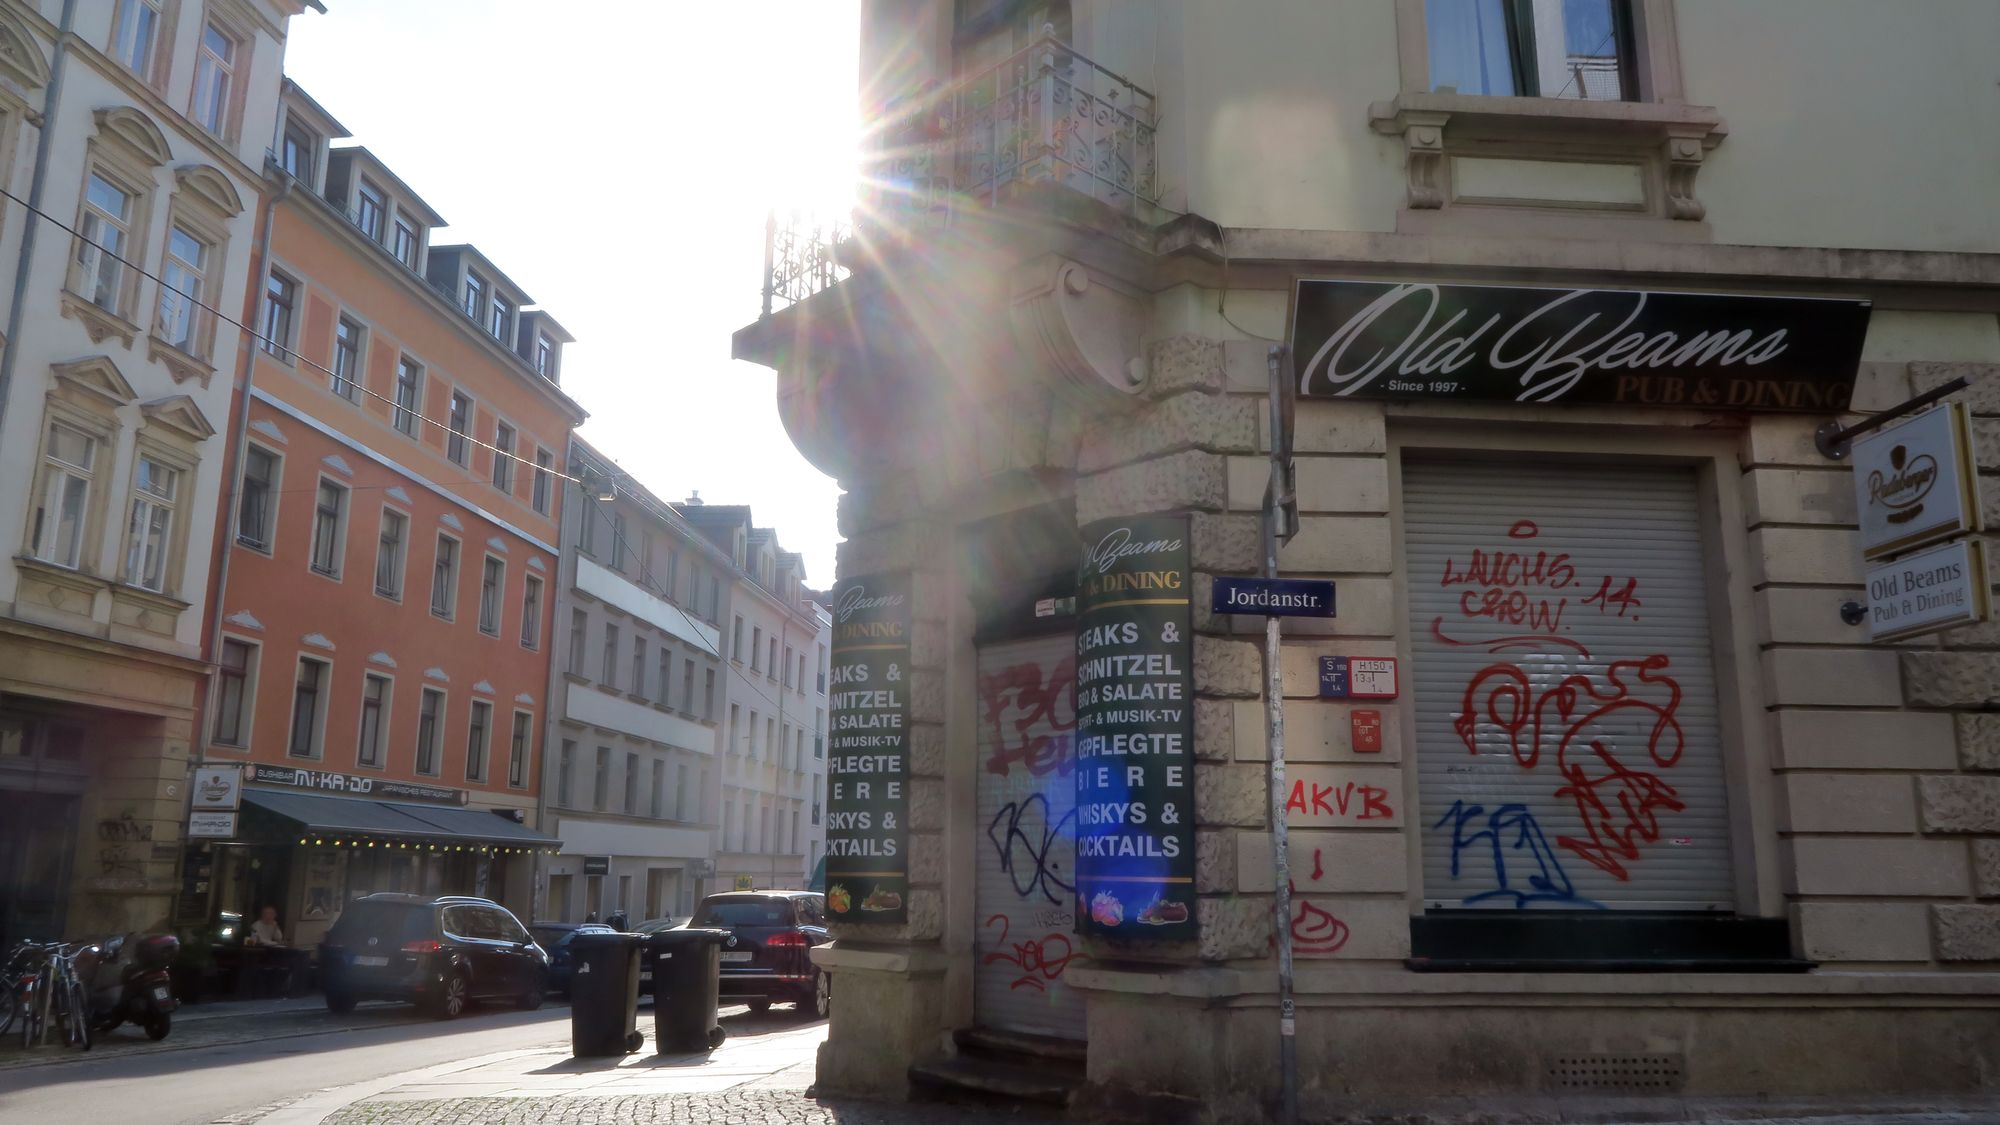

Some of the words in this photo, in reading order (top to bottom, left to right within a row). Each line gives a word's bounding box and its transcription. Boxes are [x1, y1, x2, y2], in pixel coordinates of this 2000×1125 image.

[1301, 282, 1495, 396] Old
[1489, 289, 1788, 402] Beams
[1388, 379, 1424, 392] Since
[1428, 381, 1459, 393] 1997
[1616, 375, 1684, 403] PUB
[1692, 377, 1719, 404] &
[1727, 379, 1850, 409] DINING
[1093, 527, 1183, 573] Beams
[1102, 570, 1181, 591] DINING
[1871, 574, 1898, 601] Old
[1903, 562, 1962, 592] Beams
[836, 585, 904, 623] Beams
[1227, 587, 1322, 608] Jordanstr.
[1873, 603, 1898, 624] Pub
[1902, 599, 1913, 616] &
[1916, 587, 1965, 612] Dining
[1078, 622, 1139, 656] STEAKS
[1161, 621, 1180, 643] &
[886, 663, 902, 681] &
[1078, 654, 1182, 686] SCHNITZEL
[1091, 686, 1099, 704] &
[1102, 683, 1182, 702] SALATE
[839, 713, 902, 729] SALATE
[1096, 711, 1103, 725] &
[1106, 710, 1182, 724] MUSIK-TV
[842, 735, 902, 748] MUSIK-TV
[1078, 733, 1183, 761] GEPFLEGTE
[882, 811, 897, 830] &
[1078, 802, 1147, 825] WHISKYS
[1161, 802, 1179, 824] &
[1078, 835, 1180, 858] COCKTAILS
